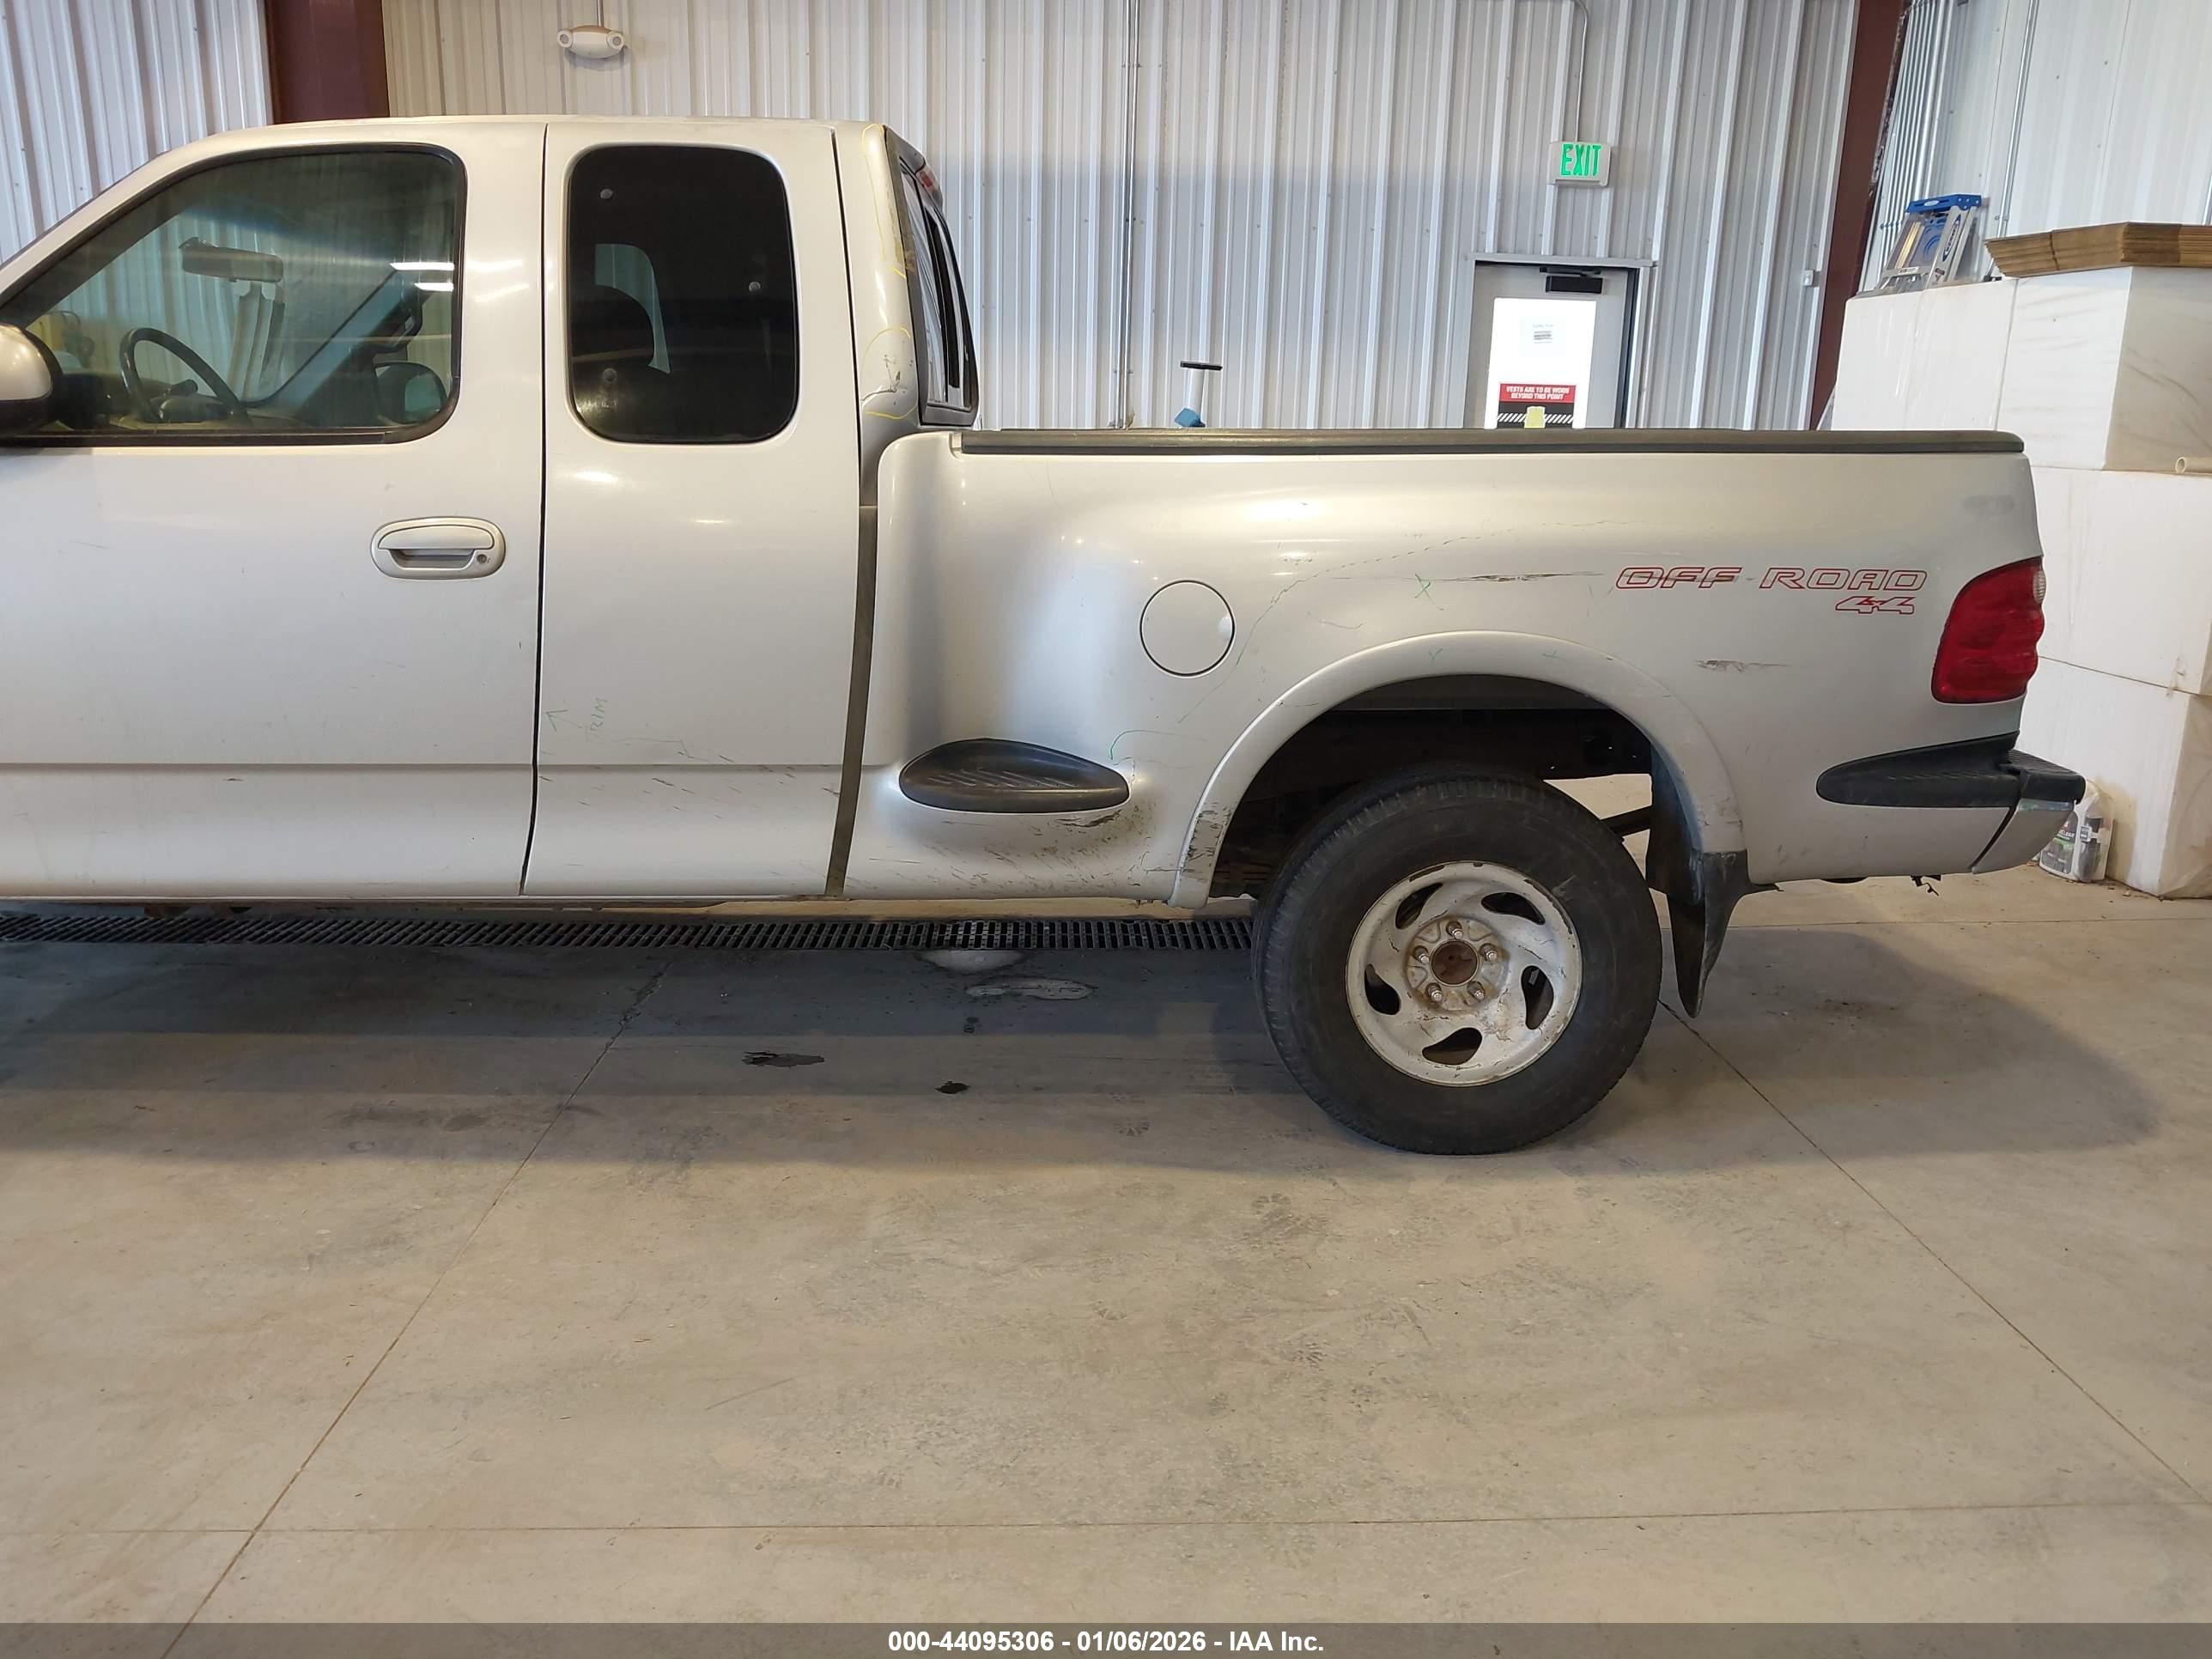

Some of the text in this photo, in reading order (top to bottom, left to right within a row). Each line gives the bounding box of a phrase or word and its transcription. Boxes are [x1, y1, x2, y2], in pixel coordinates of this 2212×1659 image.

[1561, 143, 1601, 176] EXIT
[1615, 567, 1928, 591] OFF ROAD
